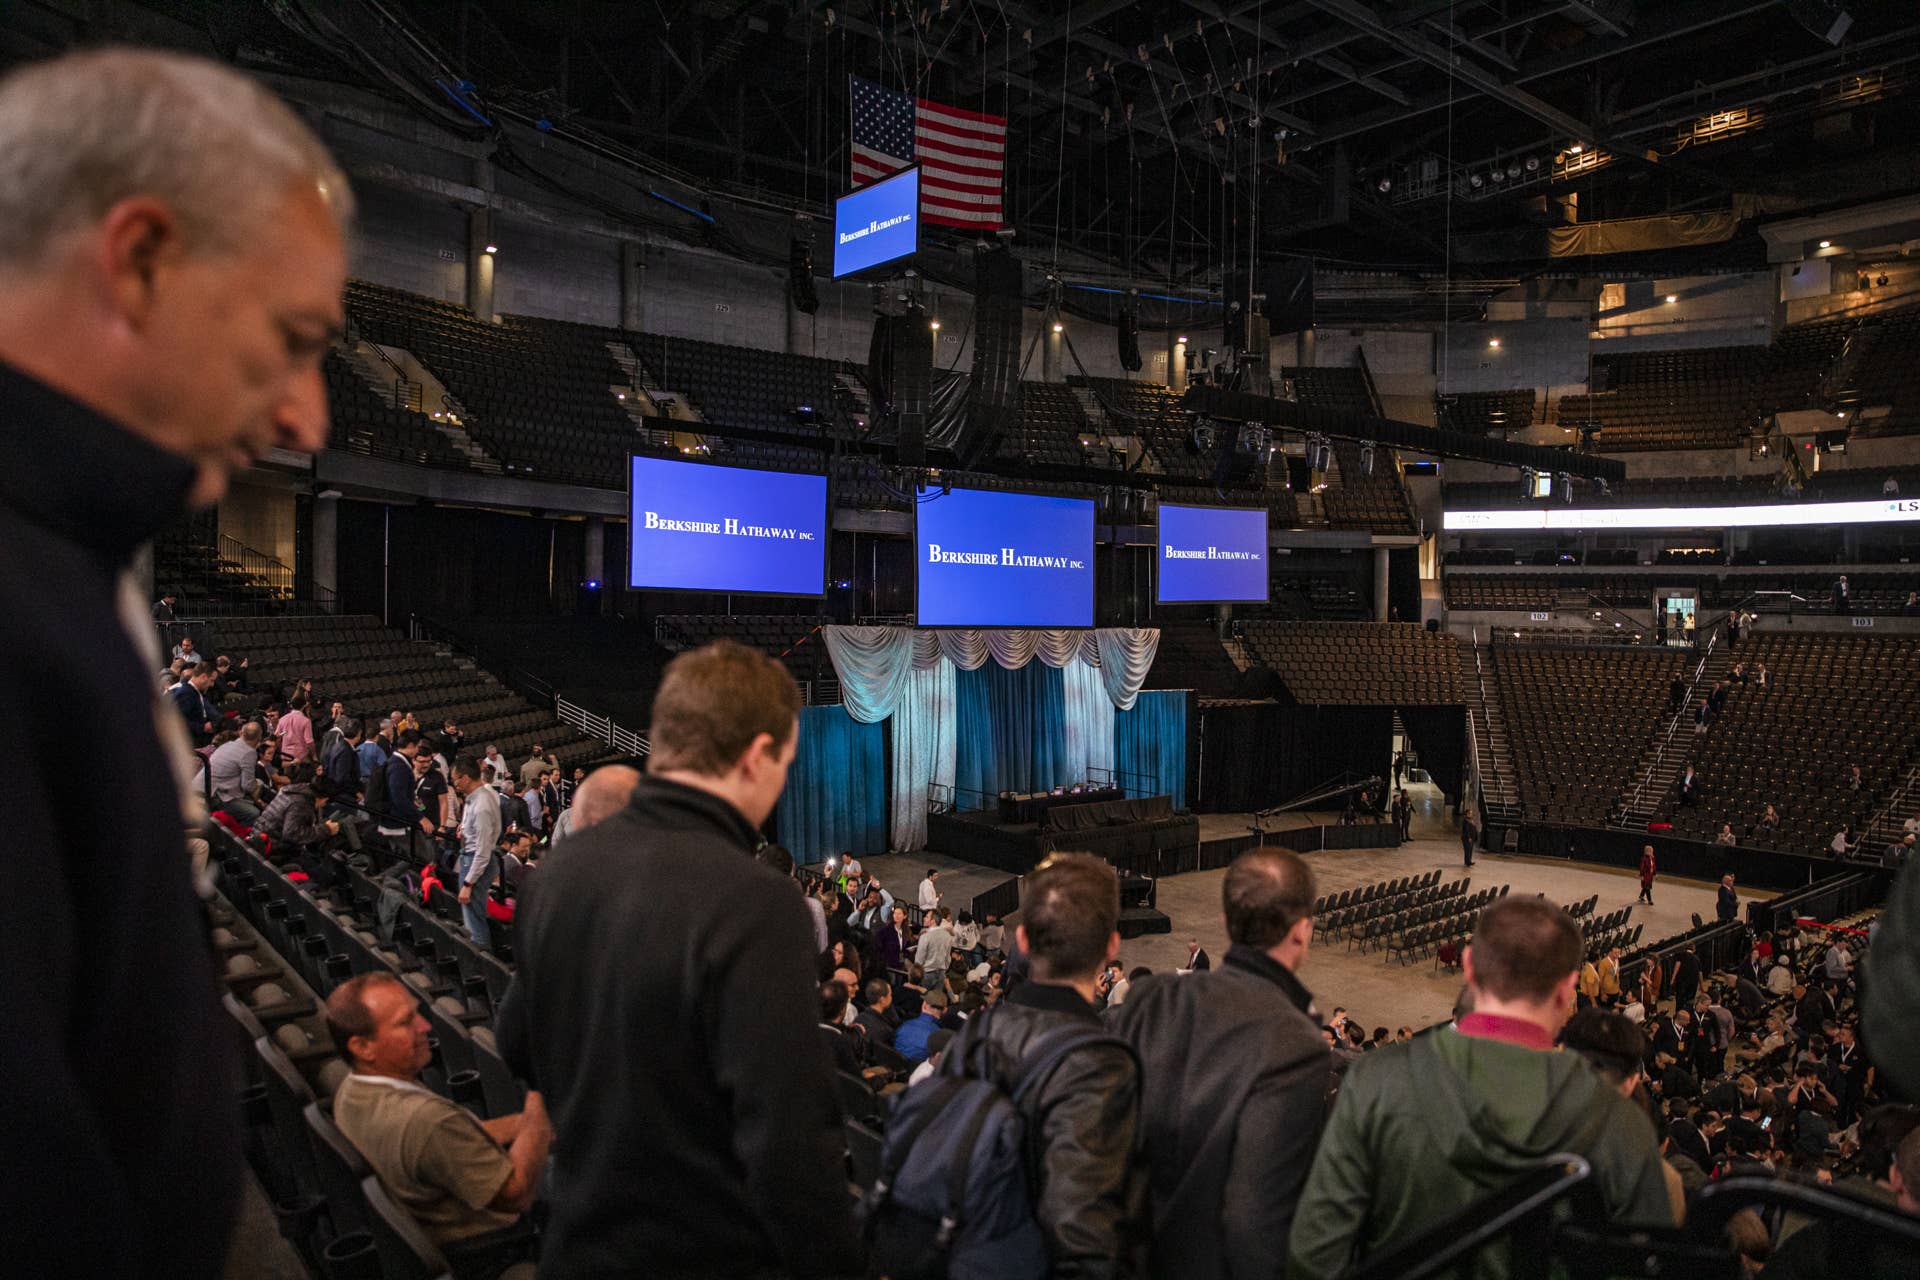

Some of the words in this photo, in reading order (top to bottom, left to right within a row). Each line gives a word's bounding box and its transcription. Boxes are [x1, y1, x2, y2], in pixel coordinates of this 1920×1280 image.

[840, 227, 869, 244] BERKSHIRE
[870, 215, 902, 233] HATHAWAY
[645, 511, 720, 534] BERKSHIRE
[724, 518, 796, 539] HATHAWAY
[799, 532, 815, 541] INC.
[928, 543, 998, 565] BERKSHIRE
[1001, 548, 1068, 569] HATHAWAY
[1070, 560, 1084, 569] INC.
[1165, 545, 1206, 559] BERKSHIRE
[1207, 546, 1249, 560] HATHAWAY
